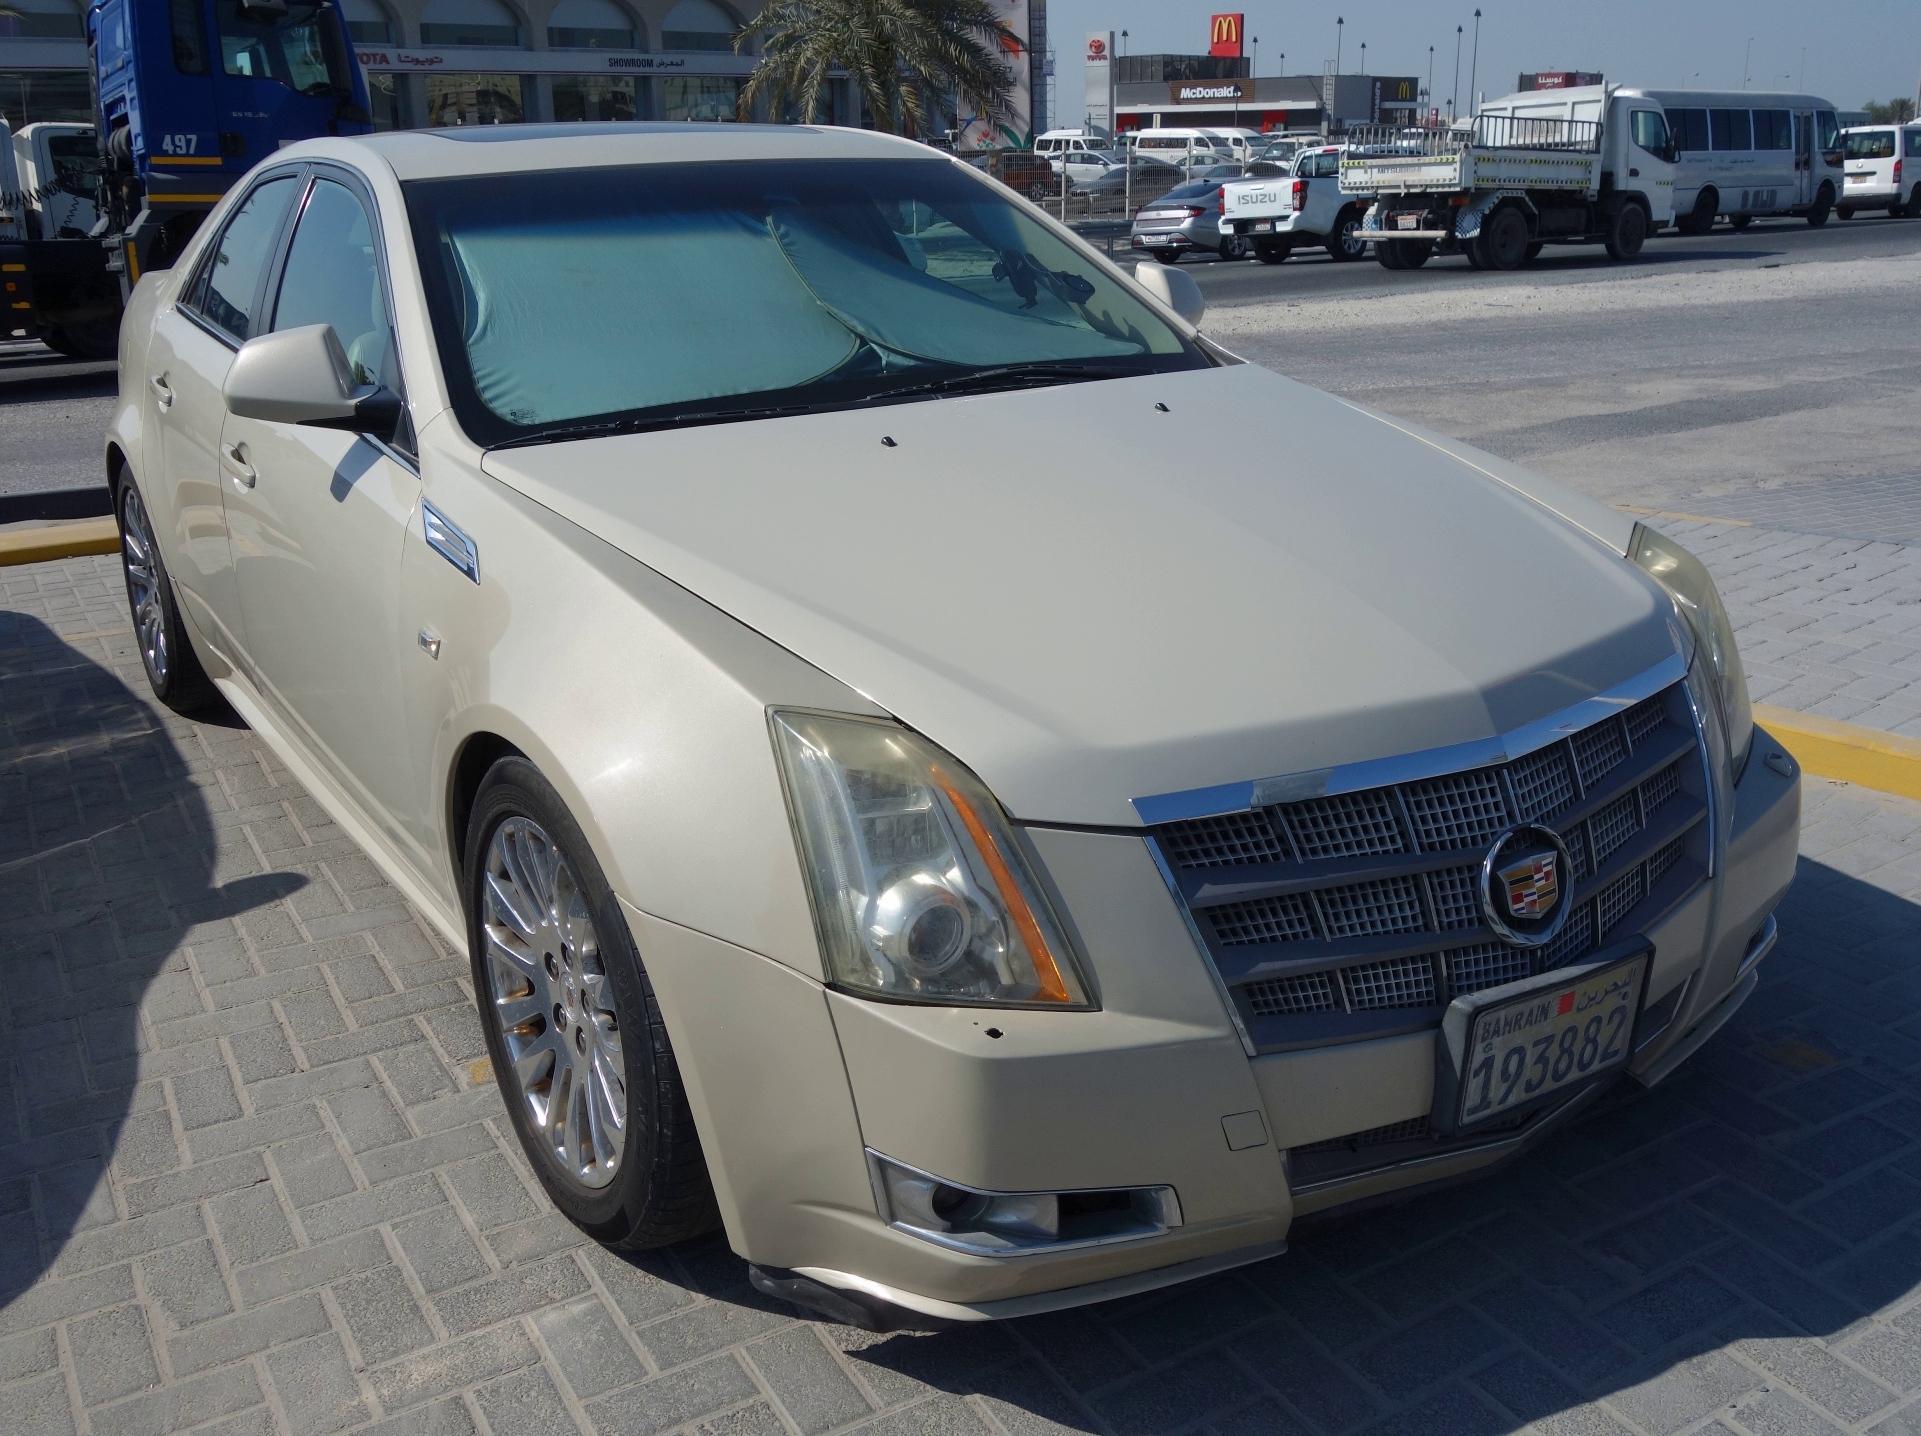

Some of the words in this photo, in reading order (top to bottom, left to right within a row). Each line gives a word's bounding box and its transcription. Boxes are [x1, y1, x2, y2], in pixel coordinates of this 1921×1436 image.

[608, 57, 654, 68] SHOWROOM
[656, 59, 685, 69] المعرض
[1180, 86, 1242, 98] McDonald
[162, 134, 198, 155] 497
[1238, 192, 1277, 205] ISUZU
[1480, 1002, 1550, 1044] BAHRAIN
[1575, 966, 1637, 1014] البحرين
[1466, 1005, 1628, 1116] 193882
